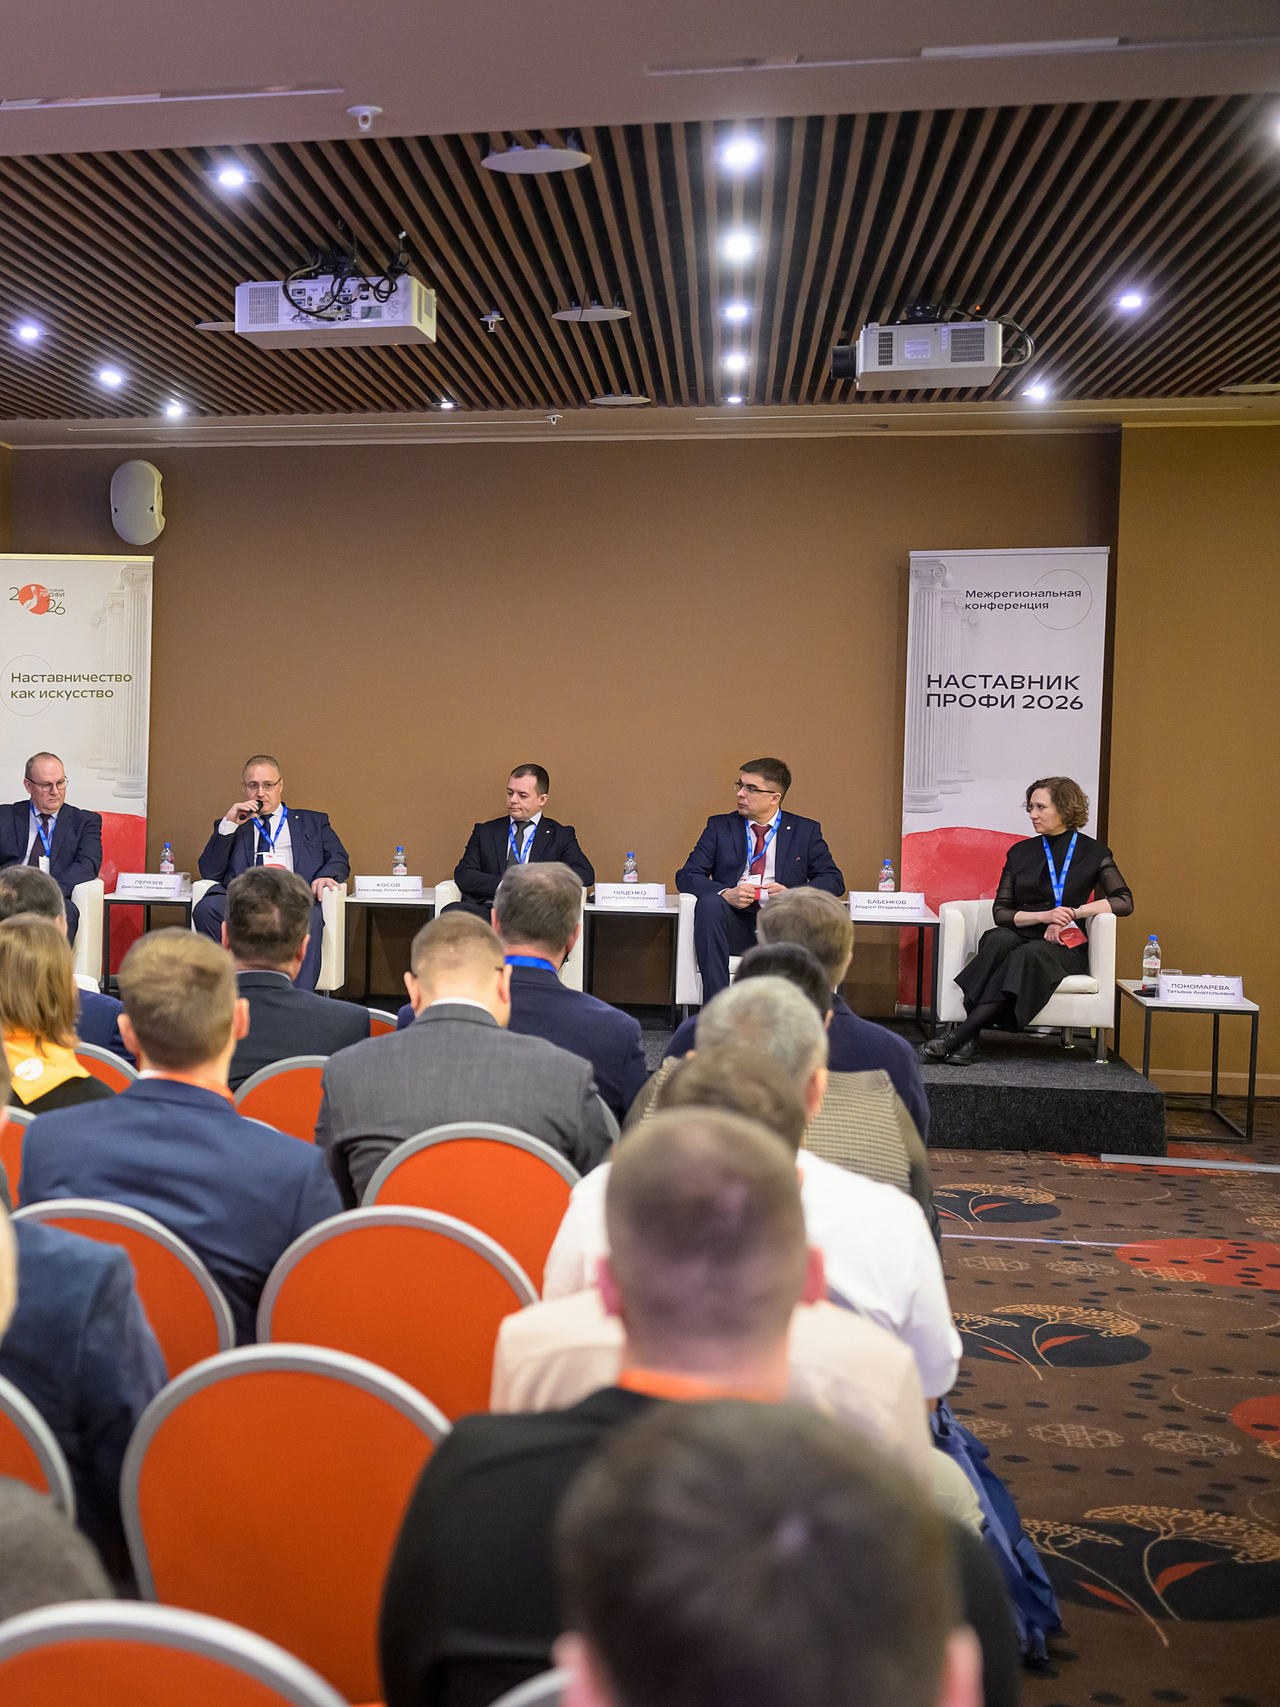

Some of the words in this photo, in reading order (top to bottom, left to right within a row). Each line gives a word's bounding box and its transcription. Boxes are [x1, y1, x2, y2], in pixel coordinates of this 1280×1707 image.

[965, 590, 1082, 599] Межрегиональная
[965, 602, 1049, 611] конференция
[11, 672, 132, 683] Наставничество
[927, 674, 1080, 690] НАСТАВНИК
[10, 690, 35, 699] как
[39, 689, 114, 700] искусство
[926, 693, 1015, 709] ПРОФИ
[1022, 695, 1084, 710] 2026
